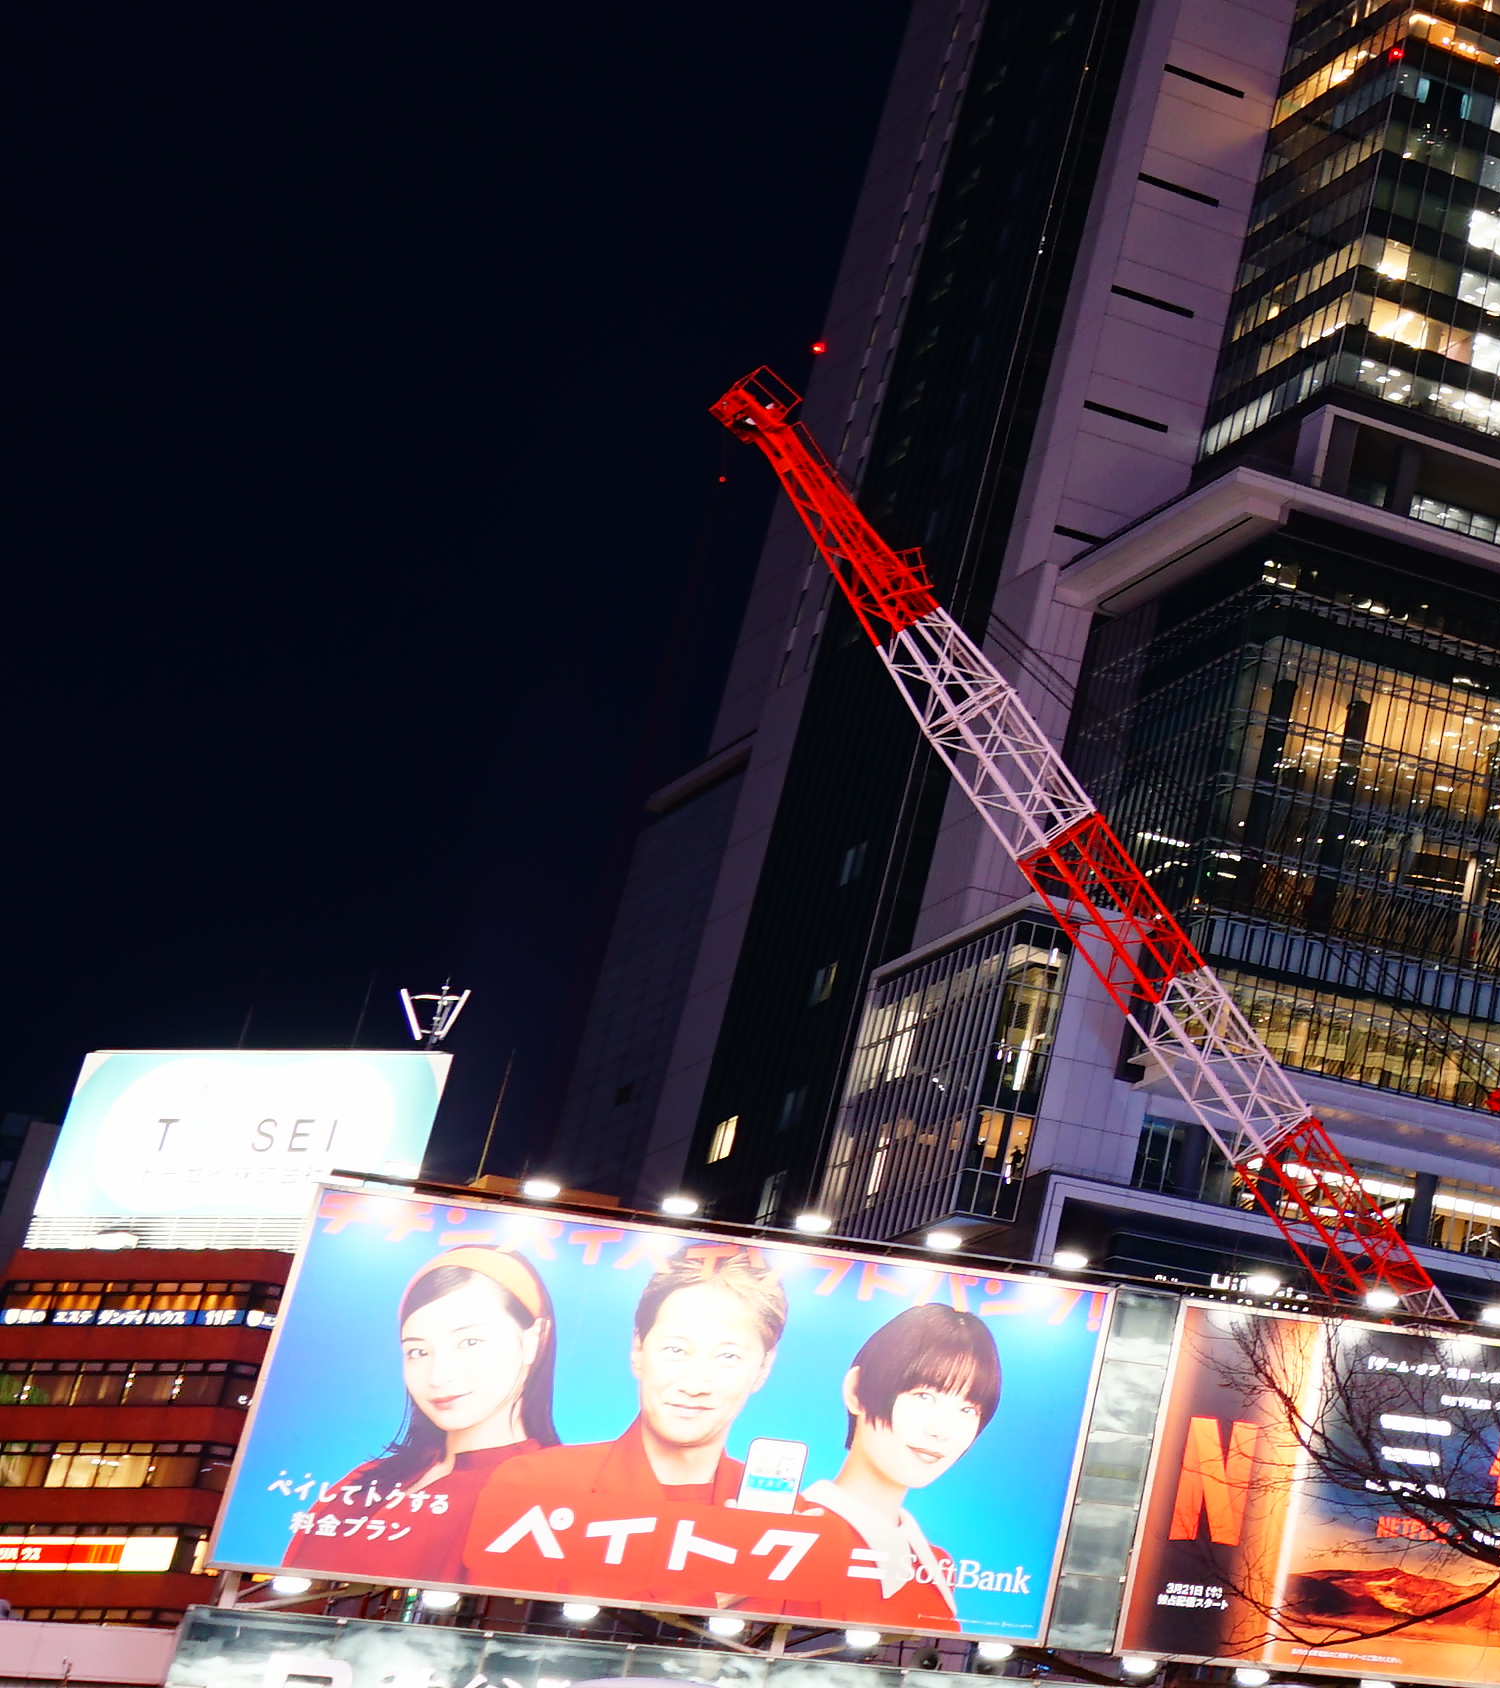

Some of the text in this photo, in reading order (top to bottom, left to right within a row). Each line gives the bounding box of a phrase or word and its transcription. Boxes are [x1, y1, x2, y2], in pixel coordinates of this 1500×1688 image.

[204, 1309, 237, 1326] 11F
[266, 1470, 450, 1515] ペイしてトクする
[288, 1511, 412, 1542] 料金プラン
[484, 1504, 821, 1582] ペイトク
[896, 1553, 1031, 1595] SoftBank
